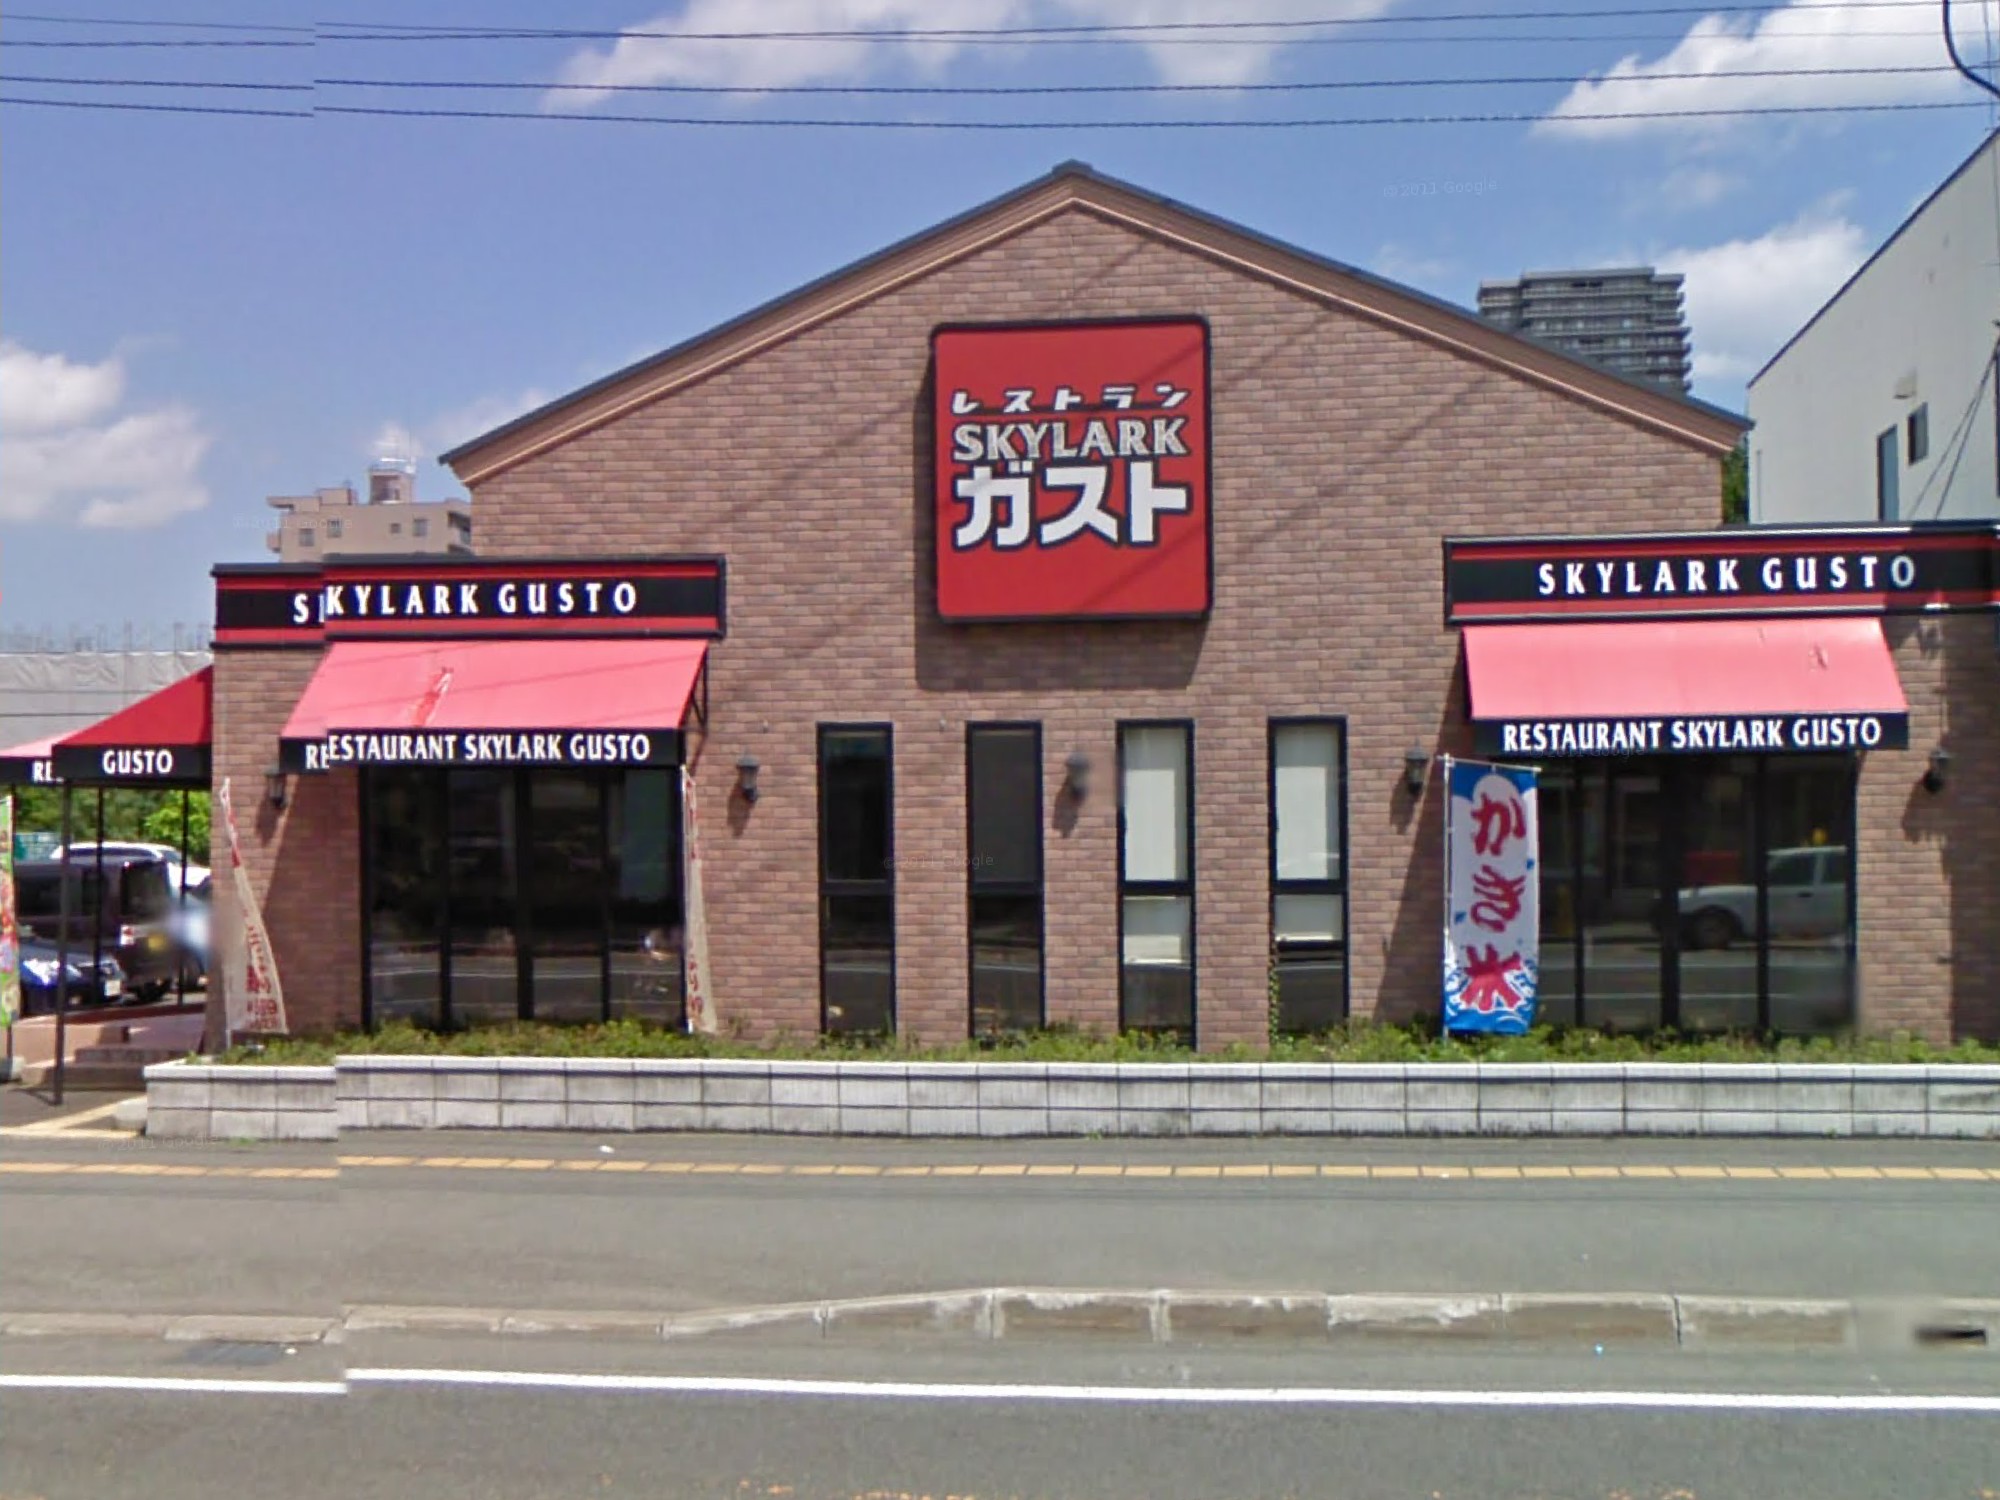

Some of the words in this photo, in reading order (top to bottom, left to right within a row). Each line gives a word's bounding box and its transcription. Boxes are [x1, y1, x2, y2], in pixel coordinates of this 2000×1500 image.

[952, 384, 1189, 414] レストラン
[953, 418, 1188, 461] SKYLARK
[956, 461, 1187, 547] ガスト
[1538, 559, 1740, 595] SKYLARK
[1762, 554, 1915, 591] GUSTO
[498, 582, 637, 614] GUSTO
[464, 733, 562, 761] SKYLARK
[570, 733, 650, 761] GUSTO
[1503, 720, 1663, 752] RESTAURANT
[1671, 718, 1783, 749] SKYLARK
[1792, 716, 1883, 746] GUSTO
[102, 749, 173, 775] GUSTO
